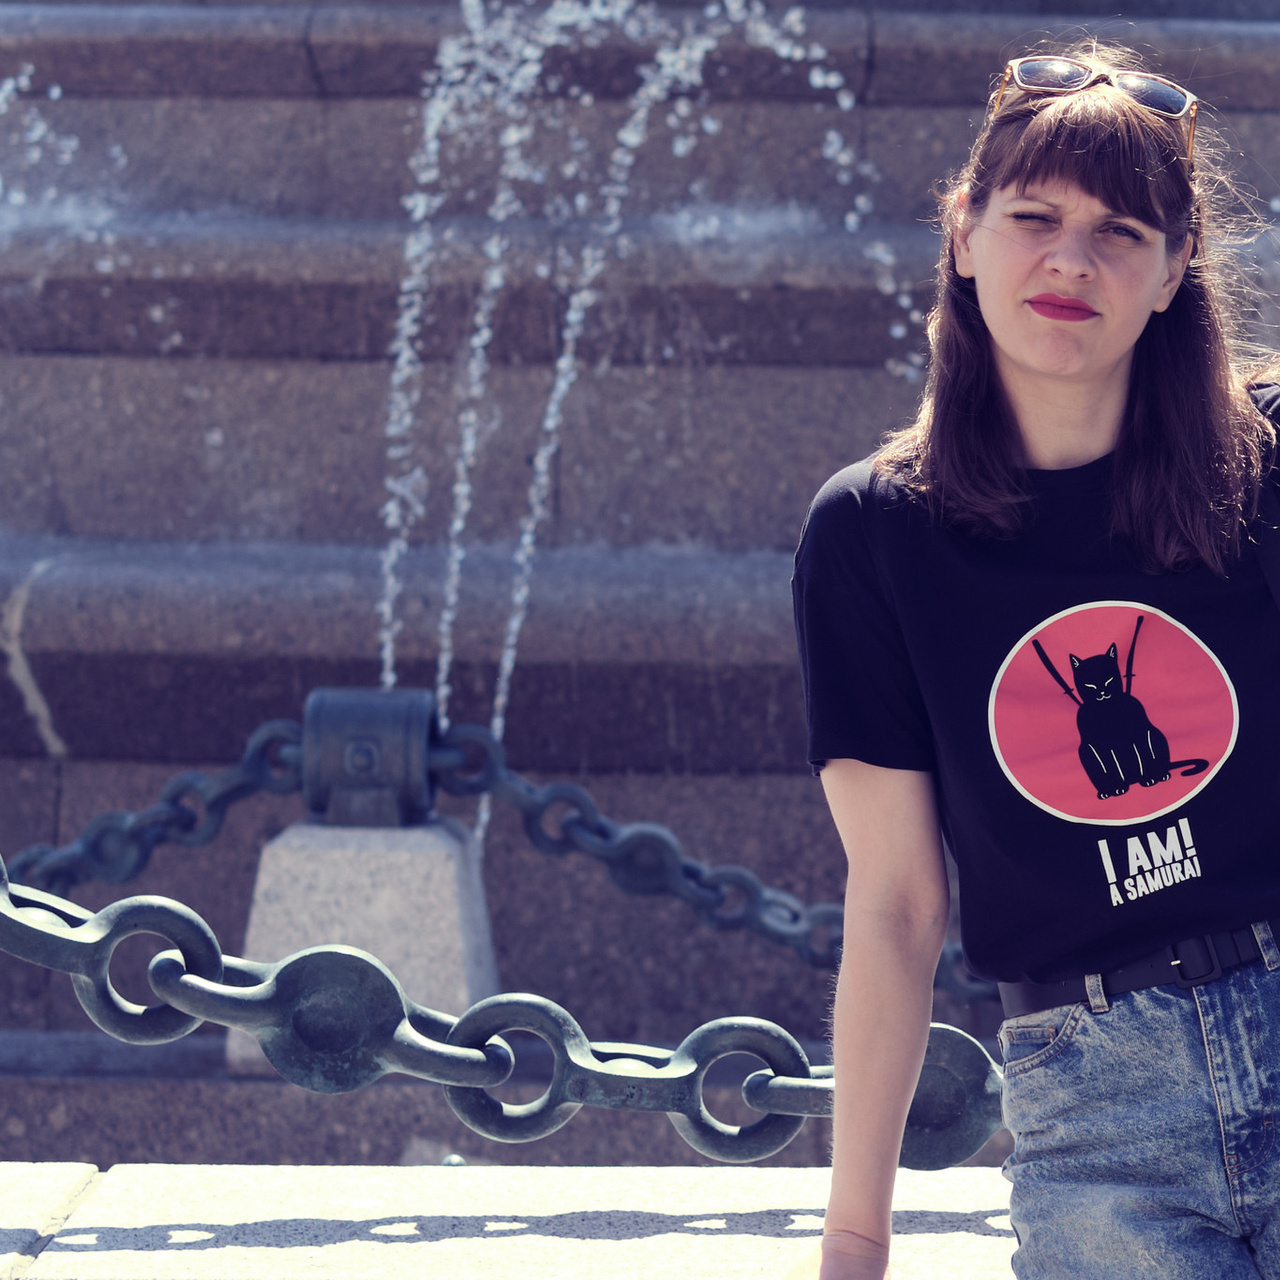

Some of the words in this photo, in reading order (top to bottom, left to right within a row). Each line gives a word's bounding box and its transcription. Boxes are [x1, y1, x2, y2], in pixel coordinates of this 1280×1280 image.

[1097, 839, 1117, 884] I
[1126, 818, 1197, 876] AM!
[1109, 883, 1124, 907] A
[1124, 856, 1202, 901] SAMURAI
